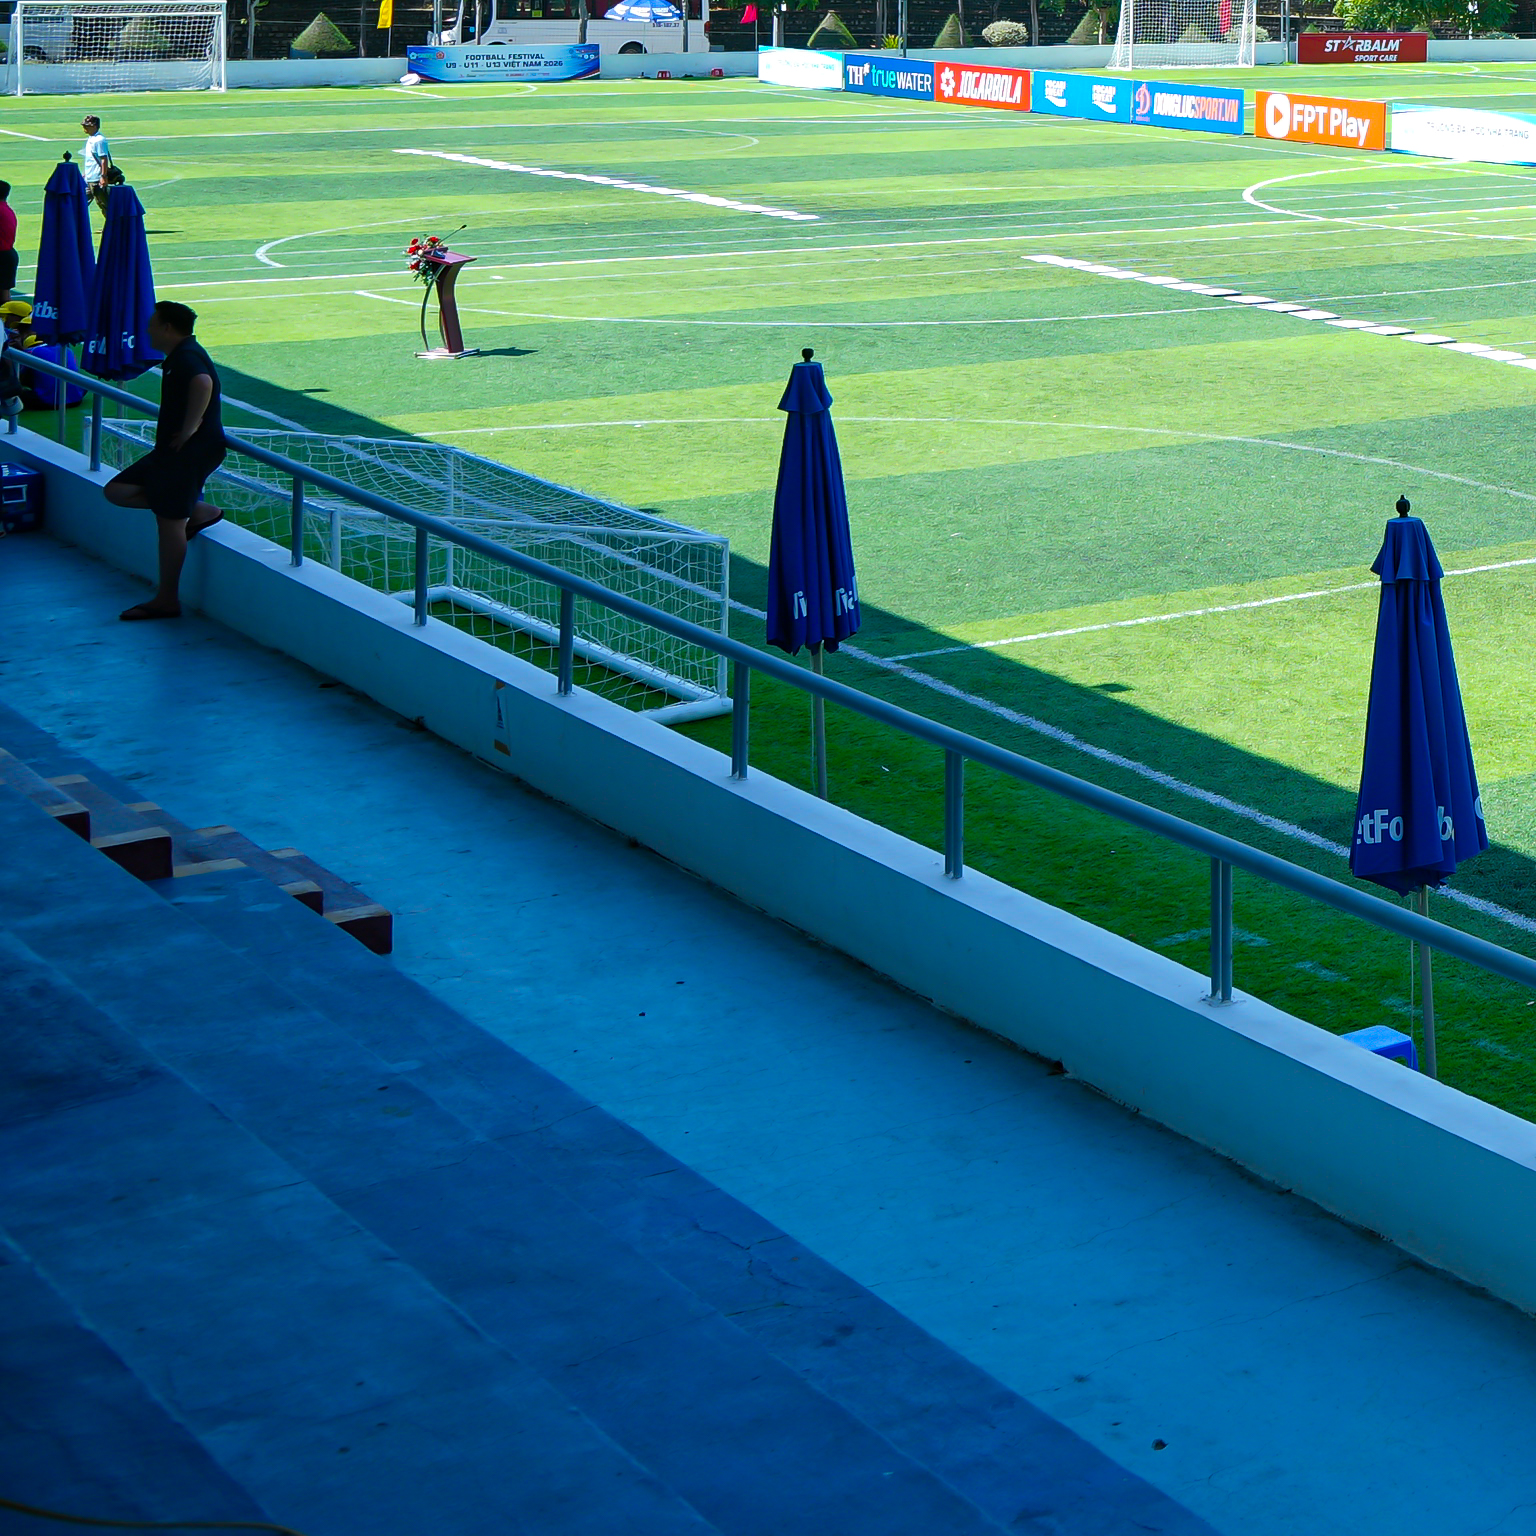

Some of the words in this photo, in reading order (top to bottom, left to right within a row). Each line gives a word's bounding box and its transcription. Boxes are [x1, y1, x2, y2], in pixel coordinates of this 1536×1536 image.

[465, 53, 505, 61] FOOTBALL
[1354, 54, 1378, 62] SPORT
[1379, 54, 1398, 62] CARE
[847, 65, 864, 86] TH
[871, 64, 896, 89] true
[896, 71, 932, 92] WATER
[957, 71, 1023, 104] JOGARBOLA
[1292, 104, 1328, 134] FPT
[1330, 106, 1370, 146] Play
